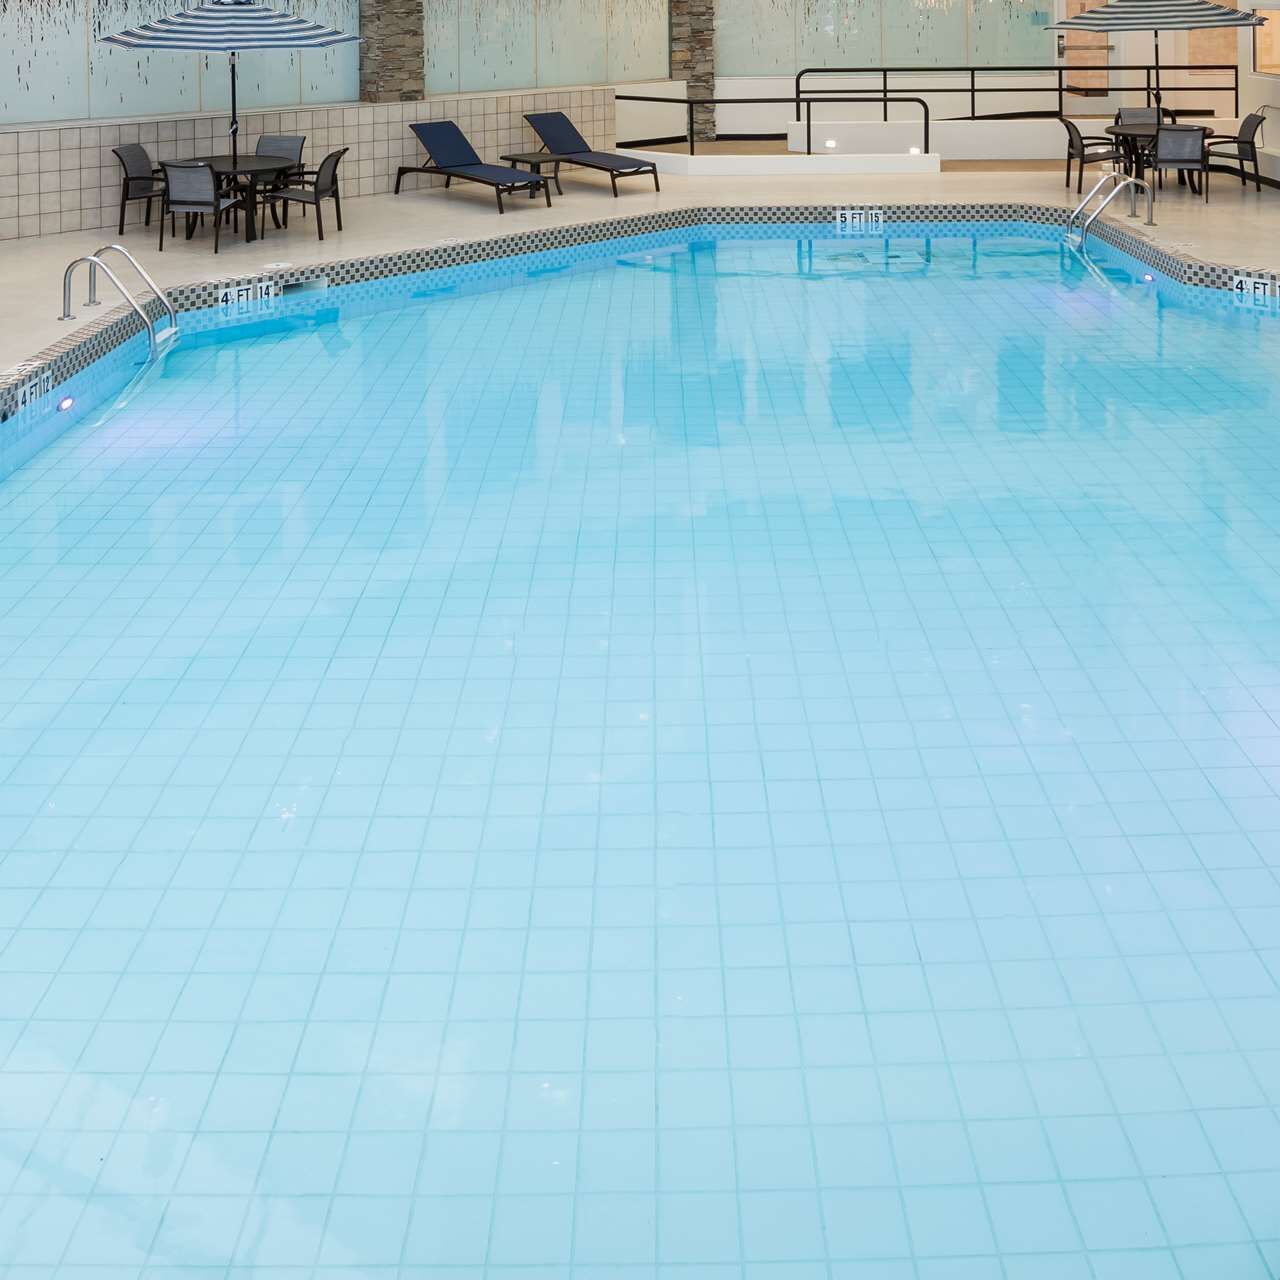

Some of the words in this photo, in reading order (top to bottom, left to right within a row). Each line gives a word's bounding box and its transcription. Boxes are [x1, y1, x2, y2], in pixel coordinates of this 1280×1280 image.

[839, 212, 847, 223] 5
[851, 212, 864, 223] FT
[237, 287, 251, 302] FT
[1253, 281, 1269, 296] FT
[21, 389, 27, 407] 4
[29, 382, 38, 403] FT
